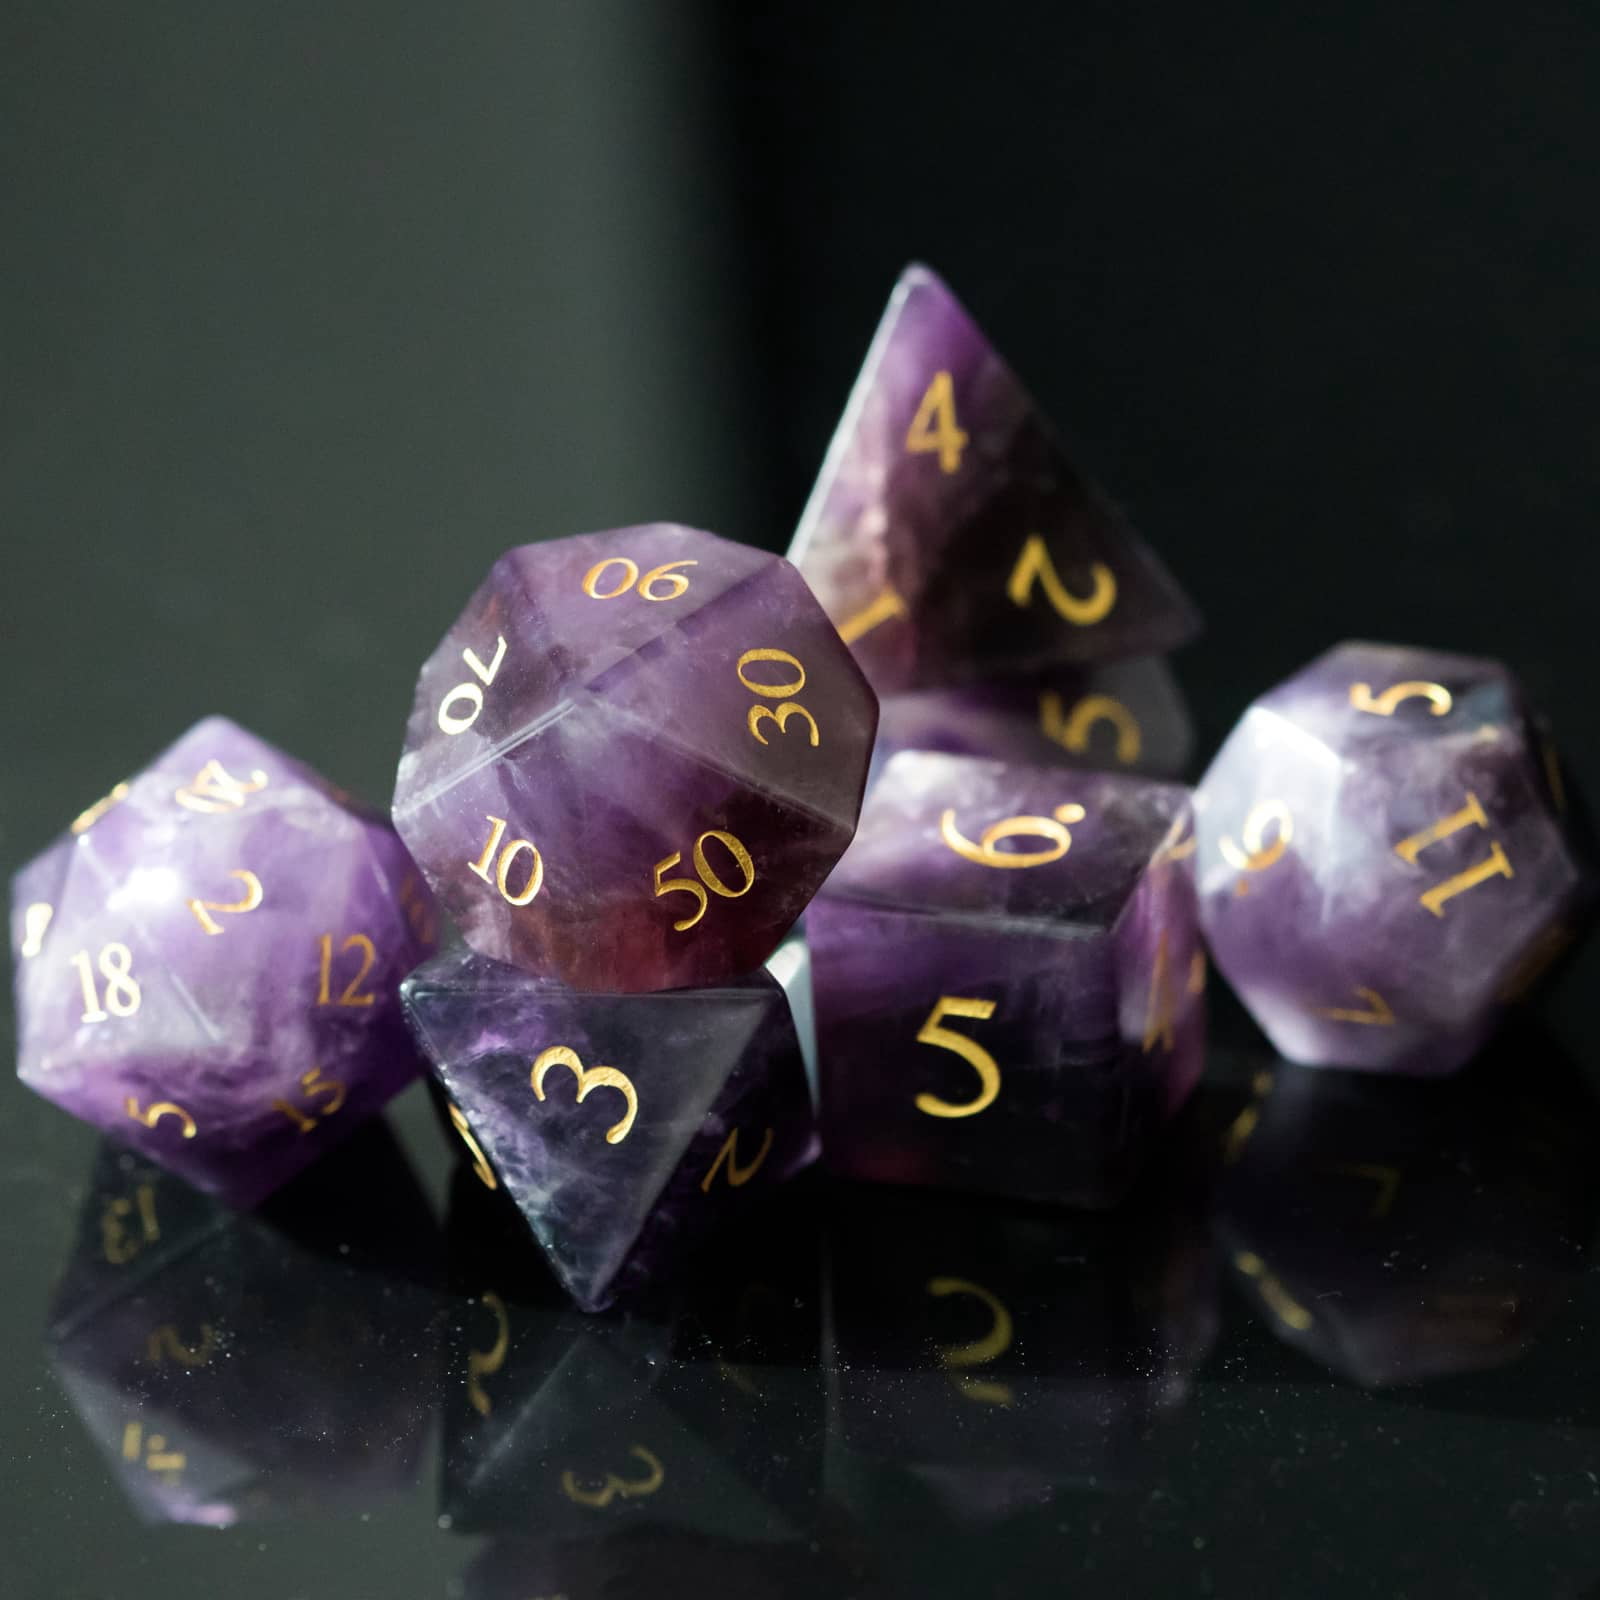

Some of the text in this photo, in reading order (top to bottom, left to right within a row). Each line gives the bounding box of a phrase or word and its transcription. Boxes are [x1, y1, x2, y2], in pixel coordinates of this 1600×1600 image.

[906, 370, 968, 475] 4
[1007, 535, 1117, 627] 2
[438, 636, 508, 736] 70
[737, 648, 821, 747] 30
[1037, 691, 1142, 765] 5
[1349, 681, 1453, 717] 5
[468, 816, 544, 906] 10
[653, 830, 755, 932] 50
[1394, 792, 1514, 918] 11
[187, 869, 264, 936] 2
[70, 942, 143, 1024] 18
[316, 933, 376, 1008] 12
[531, 1045, 639, 1145] 3
[915, 996, 1001, 1119] 5
[123, 1096, 198, 1139] 5
